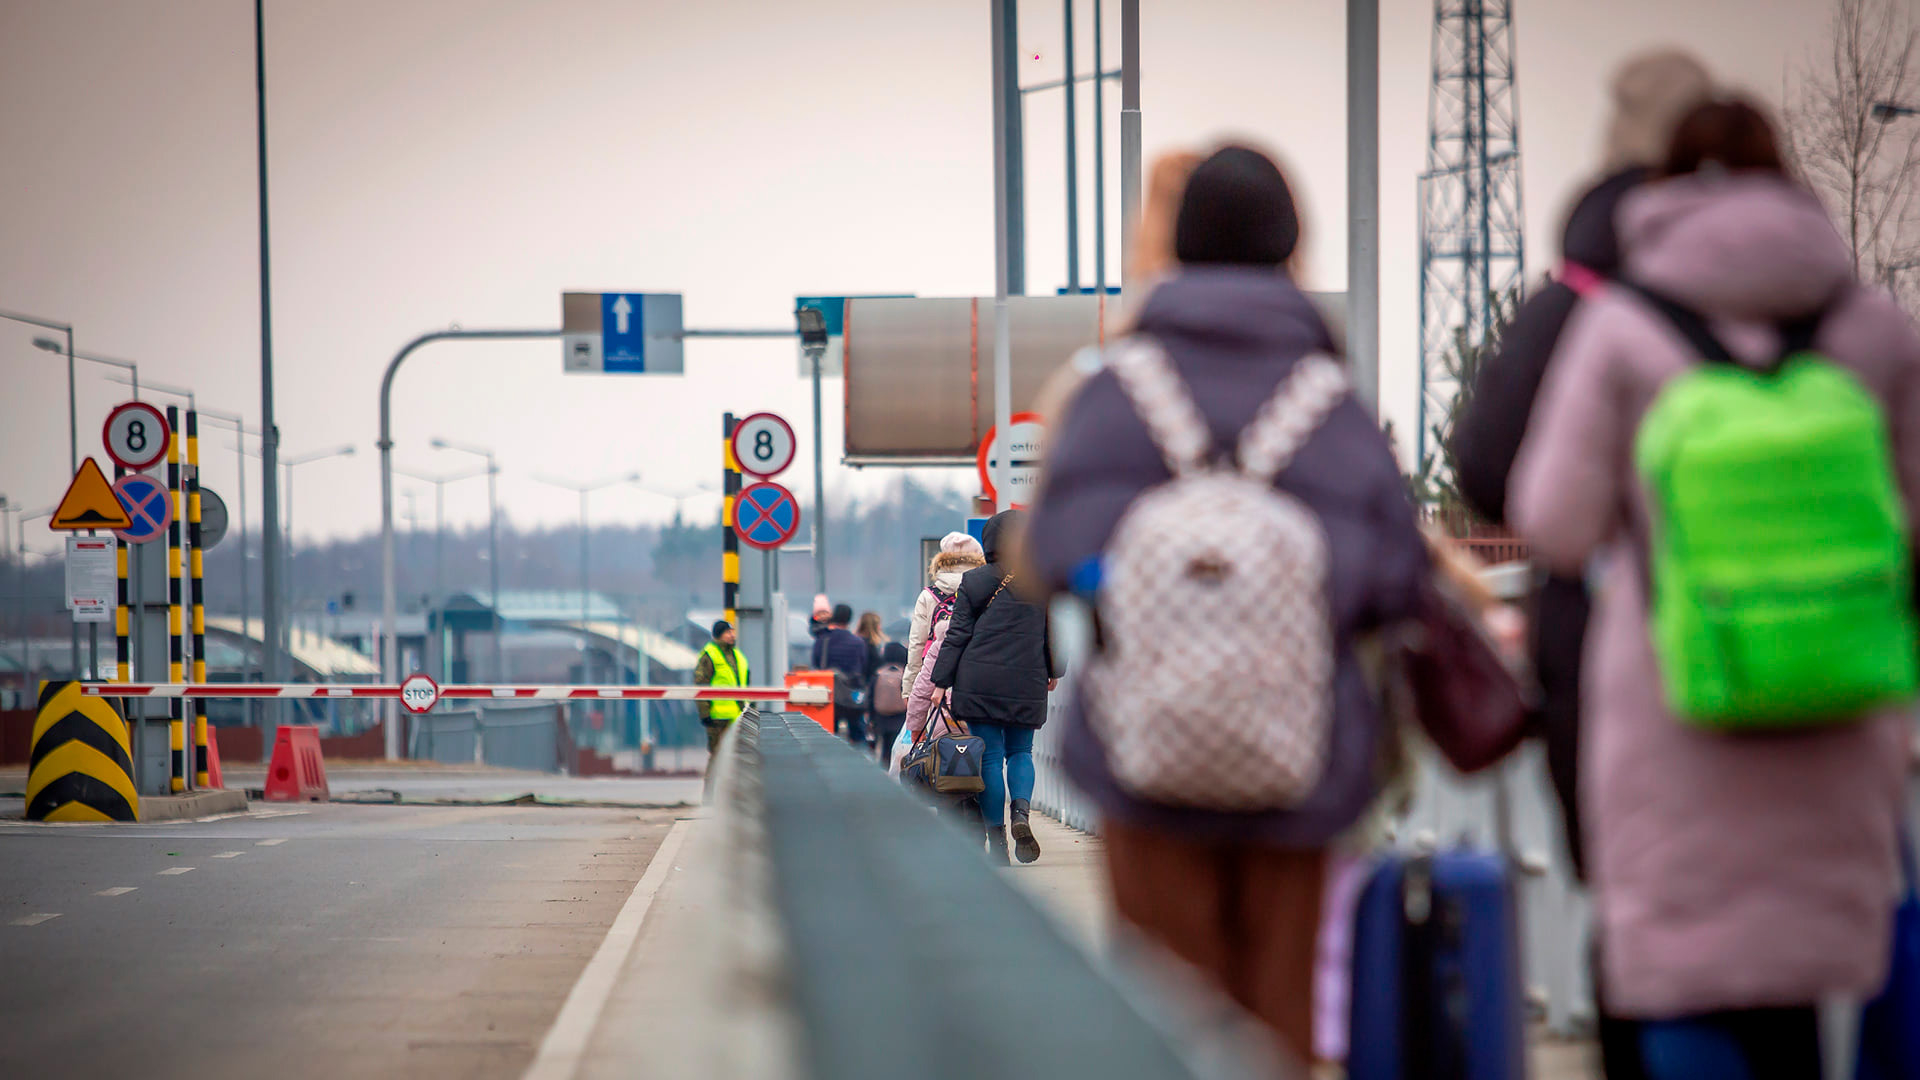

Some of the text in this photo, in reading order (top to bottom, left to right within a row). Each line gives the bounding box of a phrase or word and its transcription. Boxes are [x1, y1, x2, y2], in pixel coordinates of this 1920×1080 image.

[127, 420, 147, 451] 8
[753, 430, 774, 460] 8
[1010, 441, 1044, 452] ontrol
[405, 689, 434, 700] STOP
